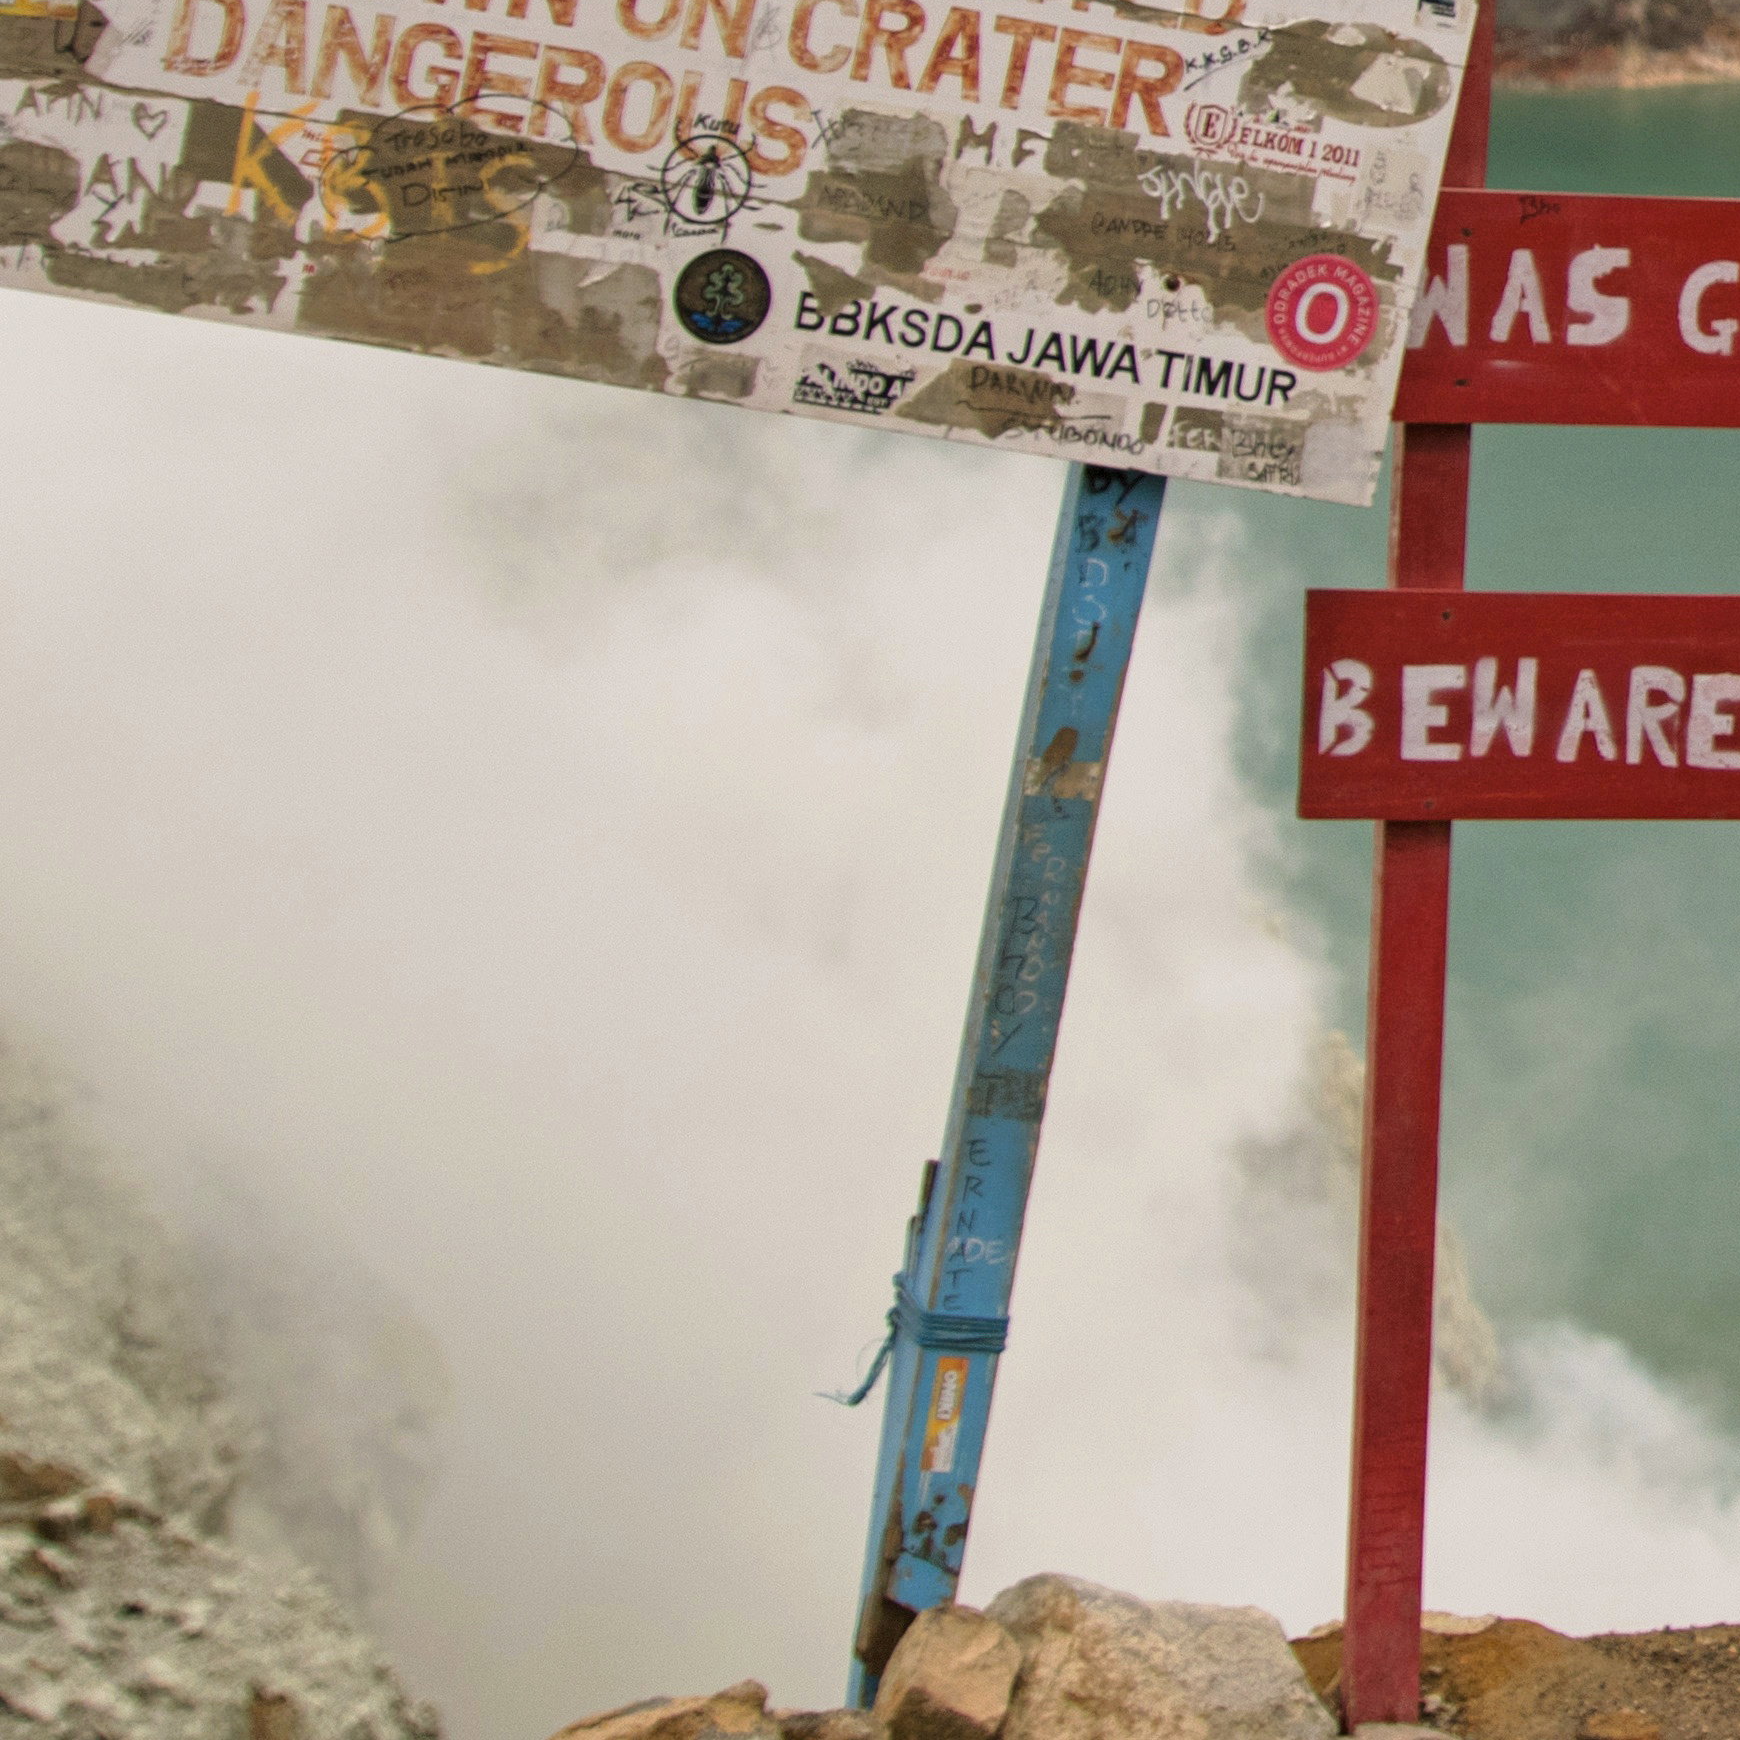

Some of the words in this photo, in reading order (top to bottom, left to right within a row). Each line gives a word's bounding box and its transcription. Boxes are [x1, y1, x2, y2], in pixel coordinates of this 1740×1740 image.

[1321, 143, 1361, 167] 2011
[1273, 263, 1328, 325] ODRADEK
[1333, 266, 1370, 346] MAGAZINE
[794, 291, 996, 361] BBKSDA
[1006, 327, 1144, 385] JAWA
[1153, 348, 1298, 407] TIMUR
